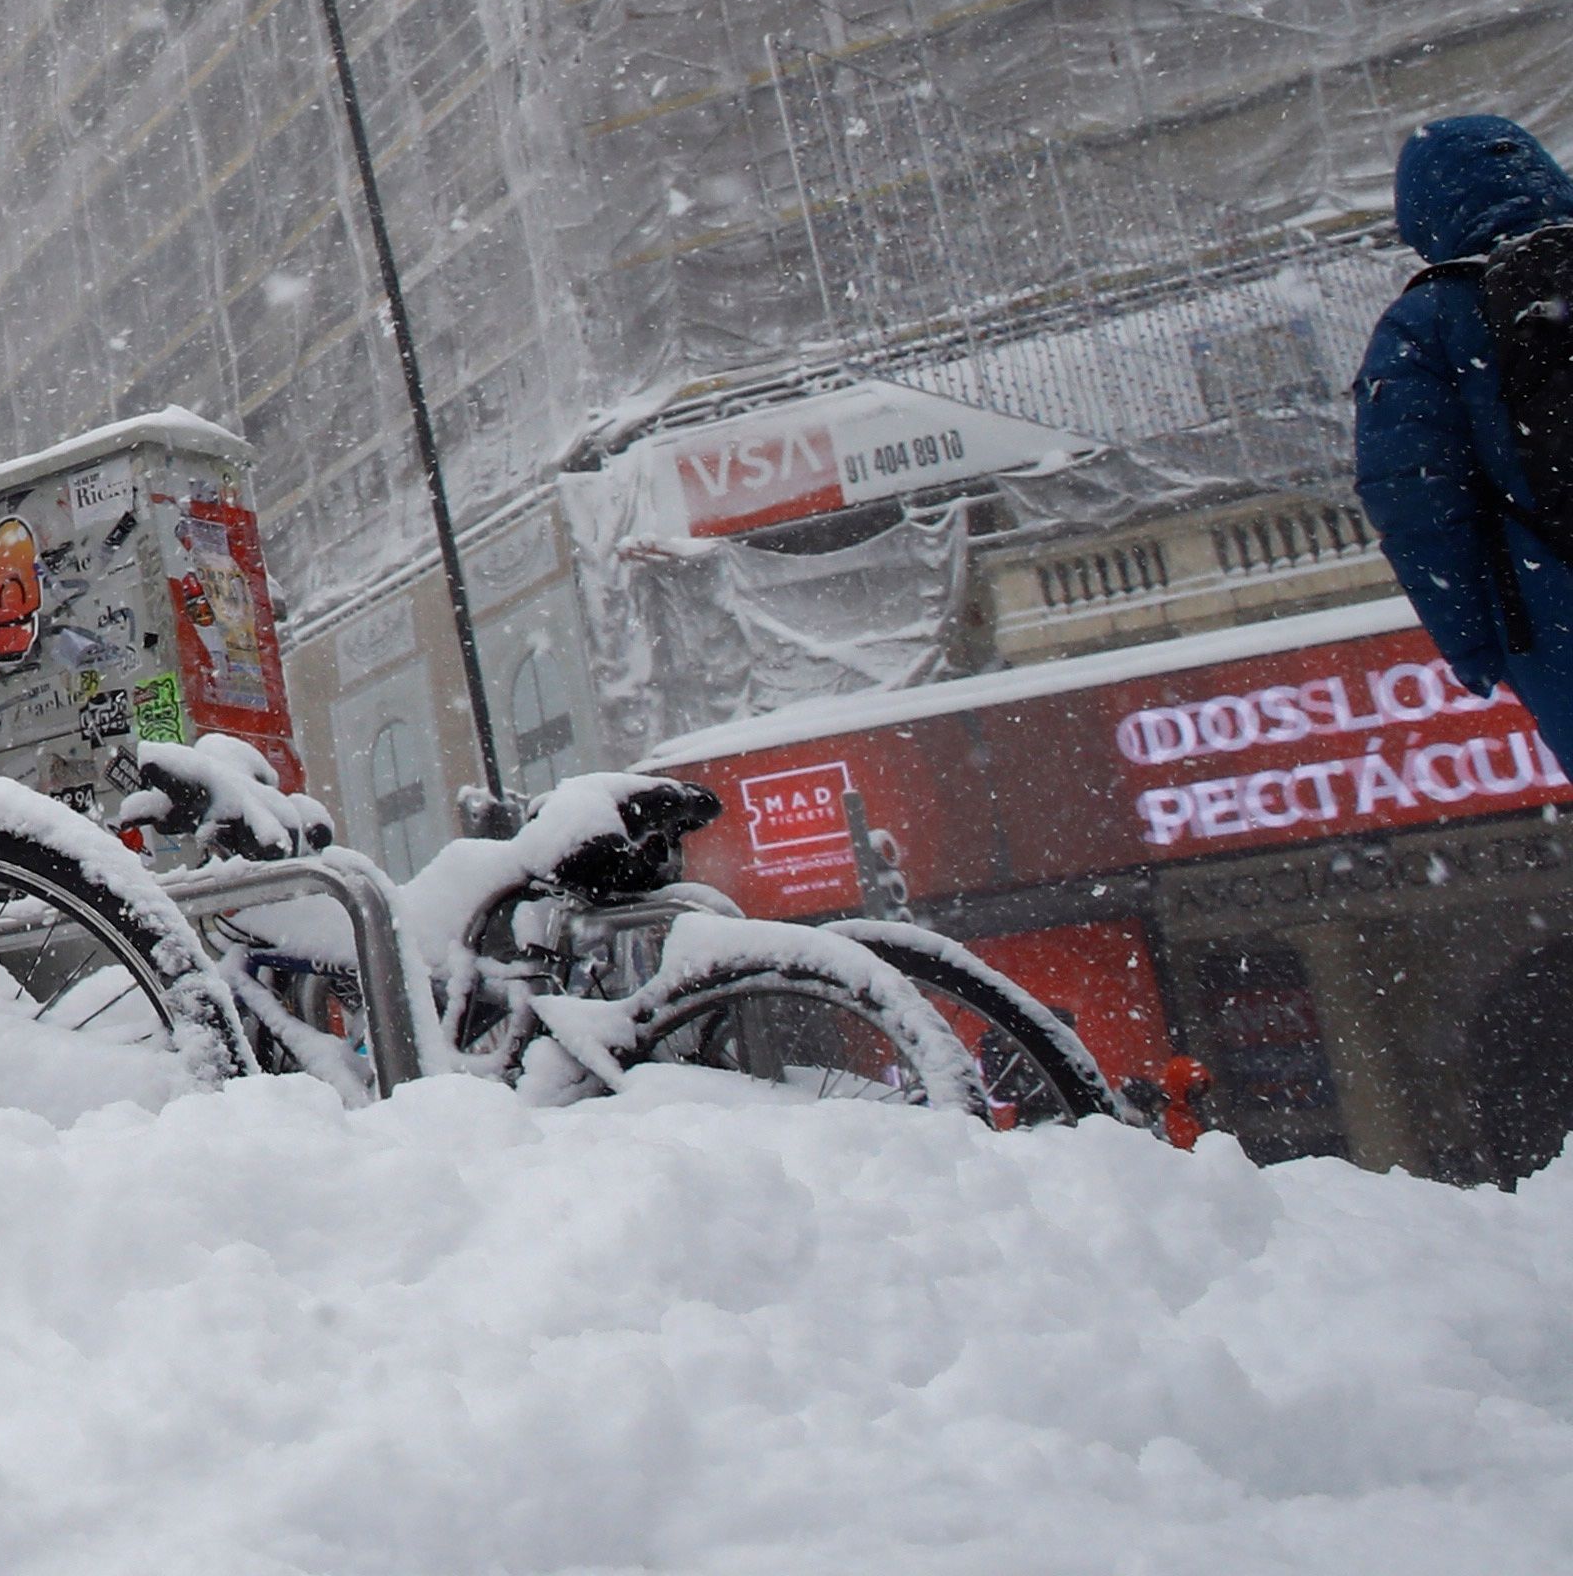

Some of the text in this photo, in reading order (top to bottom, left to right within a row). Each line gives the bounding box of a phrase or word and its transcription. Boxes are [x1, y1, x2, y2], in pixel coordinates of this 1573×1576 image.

[689, 432, 824, 498] VSA
[844, 454, 867, 484] 91
[873, 445, 910, 476] 404
[914, 436, 940, 467] 89
[764, 786, 832, 814] MAD
[768, 806, 837, 826] TICKETS
